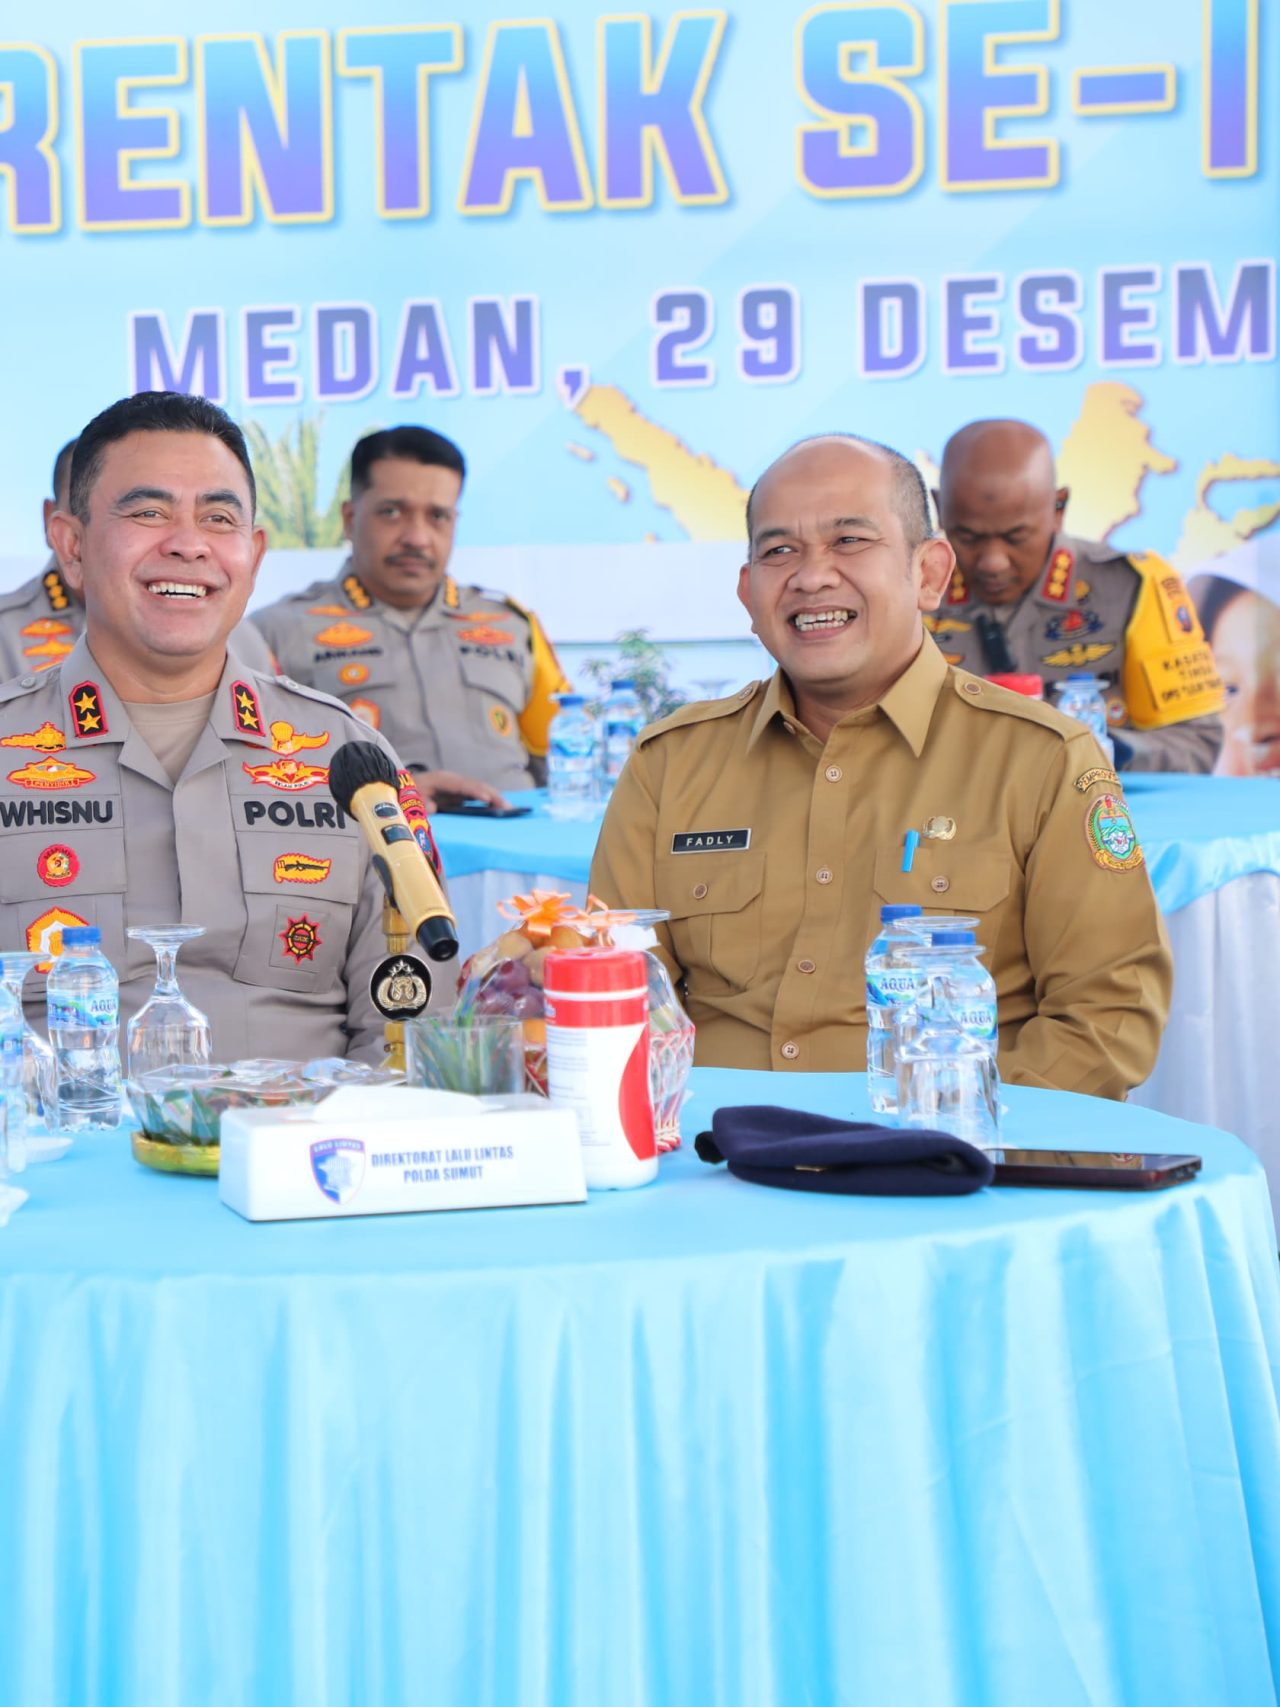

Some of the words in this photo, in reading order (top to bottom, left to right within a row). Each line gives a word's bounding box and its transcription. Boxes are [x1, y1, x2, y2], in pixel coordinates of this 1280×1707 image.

[131, 296, 587, 403] MEDAN,
[654, 288, 798, 384] 29
[860, 262, 1273, 375] DESEM
[243, 800, 347, 830] POLRI
[686, 834, 734, 847] FADLY
[880, 977, 916, 993] AQUA
[959, 1010, 993, 1026] AQUA
[371, 1149, 442, 1167] DIREKTORAT
[445, 1148, 471, 1163] LALU
[474, 1145, 514, 1161] LINTAS
[403, 1168, 440, 1184] POLDA
[443, 1165, 483, 1181] SUMUT
